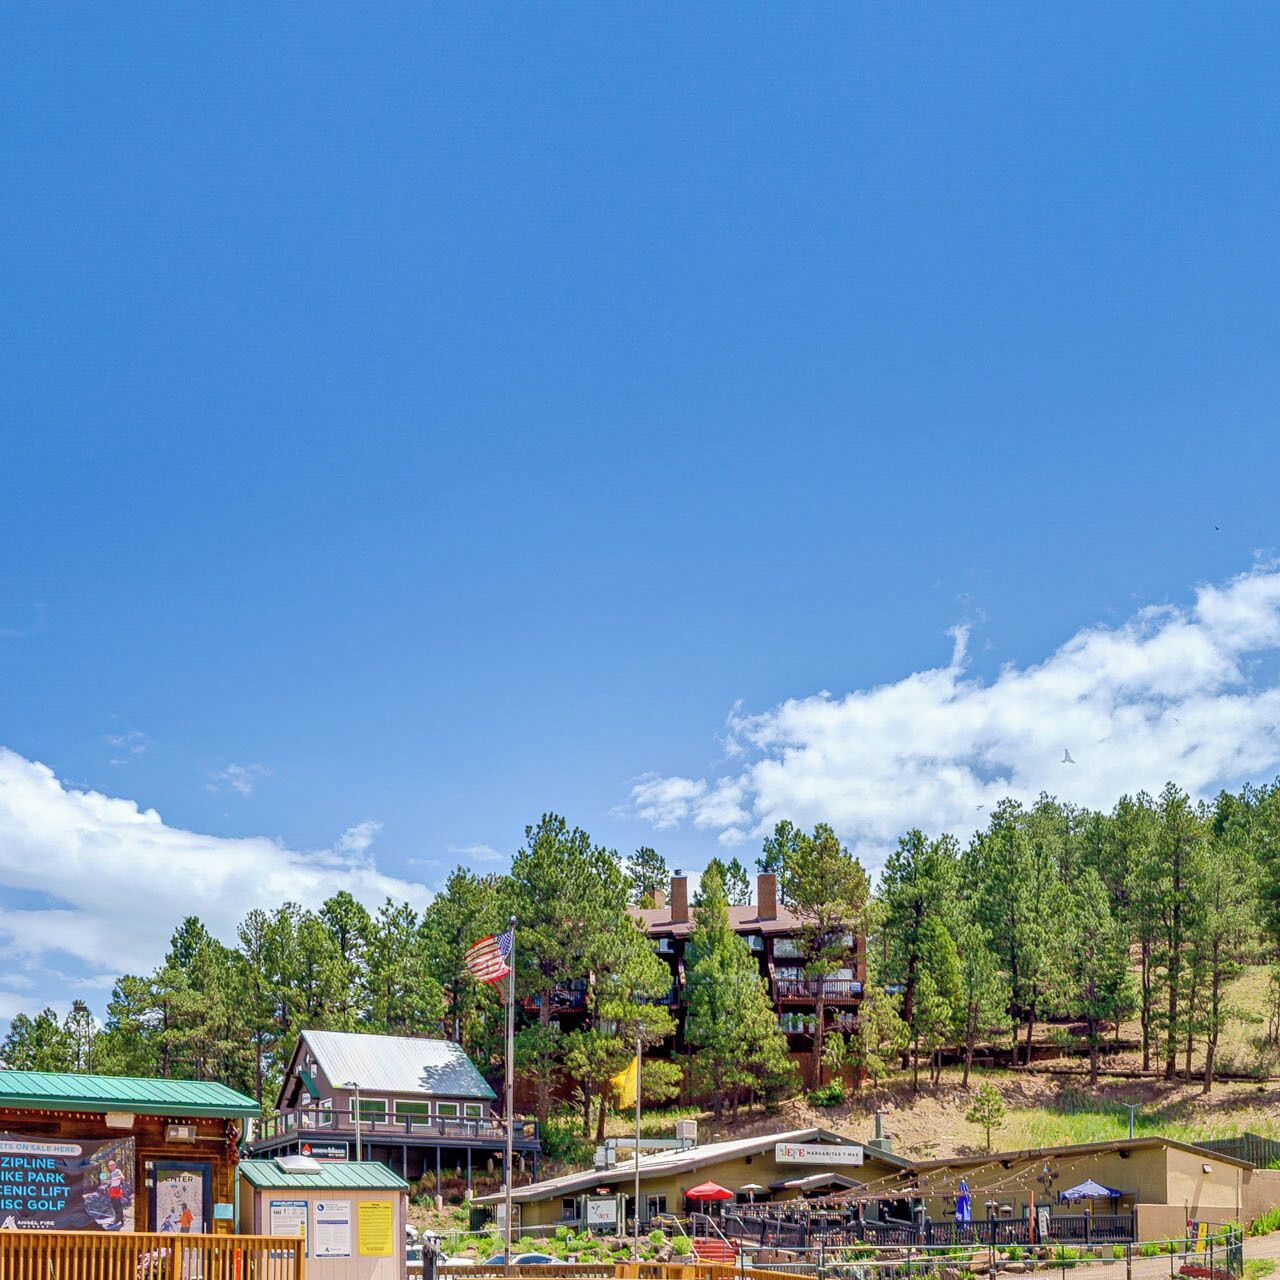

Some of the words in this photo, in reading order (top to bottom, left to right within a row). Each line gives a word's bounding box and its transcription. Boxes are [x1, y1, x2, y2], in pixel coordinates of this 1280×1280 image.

[0, 1156, 56, 1169] ZIPLINE
[27, 1172, 65, 1183] PARK
[41, 1186, 70, 1197] LIFT
[27, 1200, 65, 1211] GOLF
